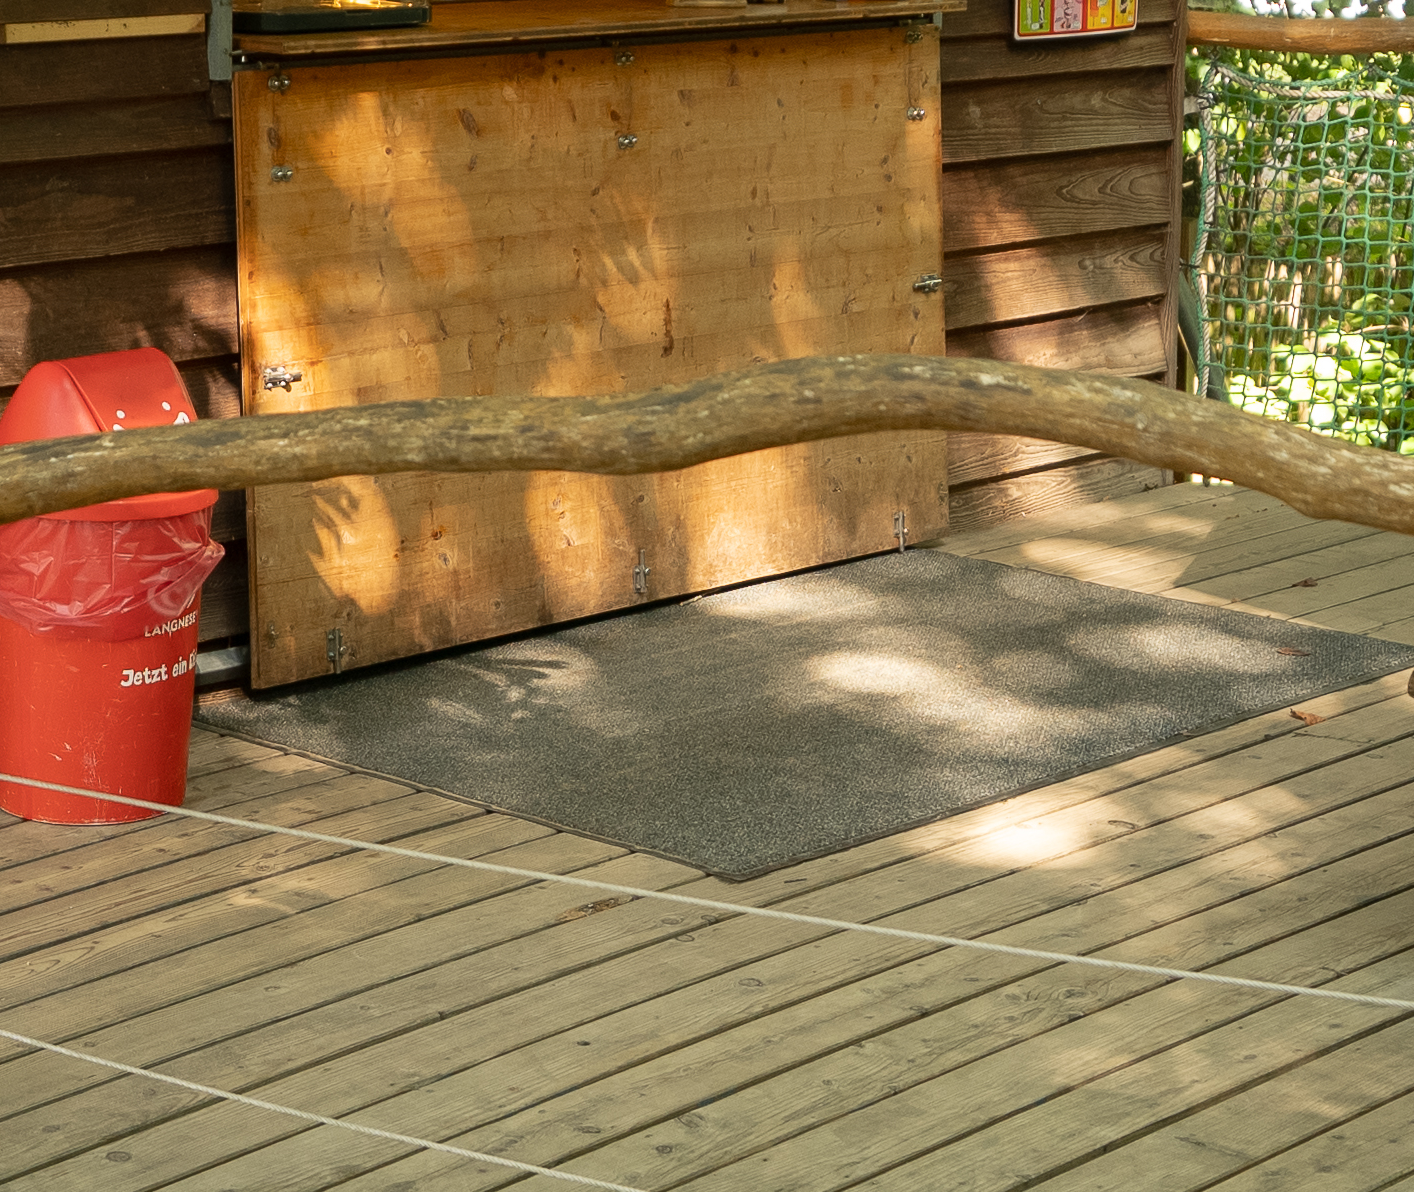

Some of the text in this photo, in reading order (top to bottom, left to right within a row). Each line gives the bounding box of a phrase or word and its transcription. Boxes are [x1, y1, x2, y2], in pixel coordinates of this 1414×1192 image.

[144, 611, 197, 637] LANGNESE
[120, 663, 168, 687] Jetzt
[172, 656, 187, 678] ein
